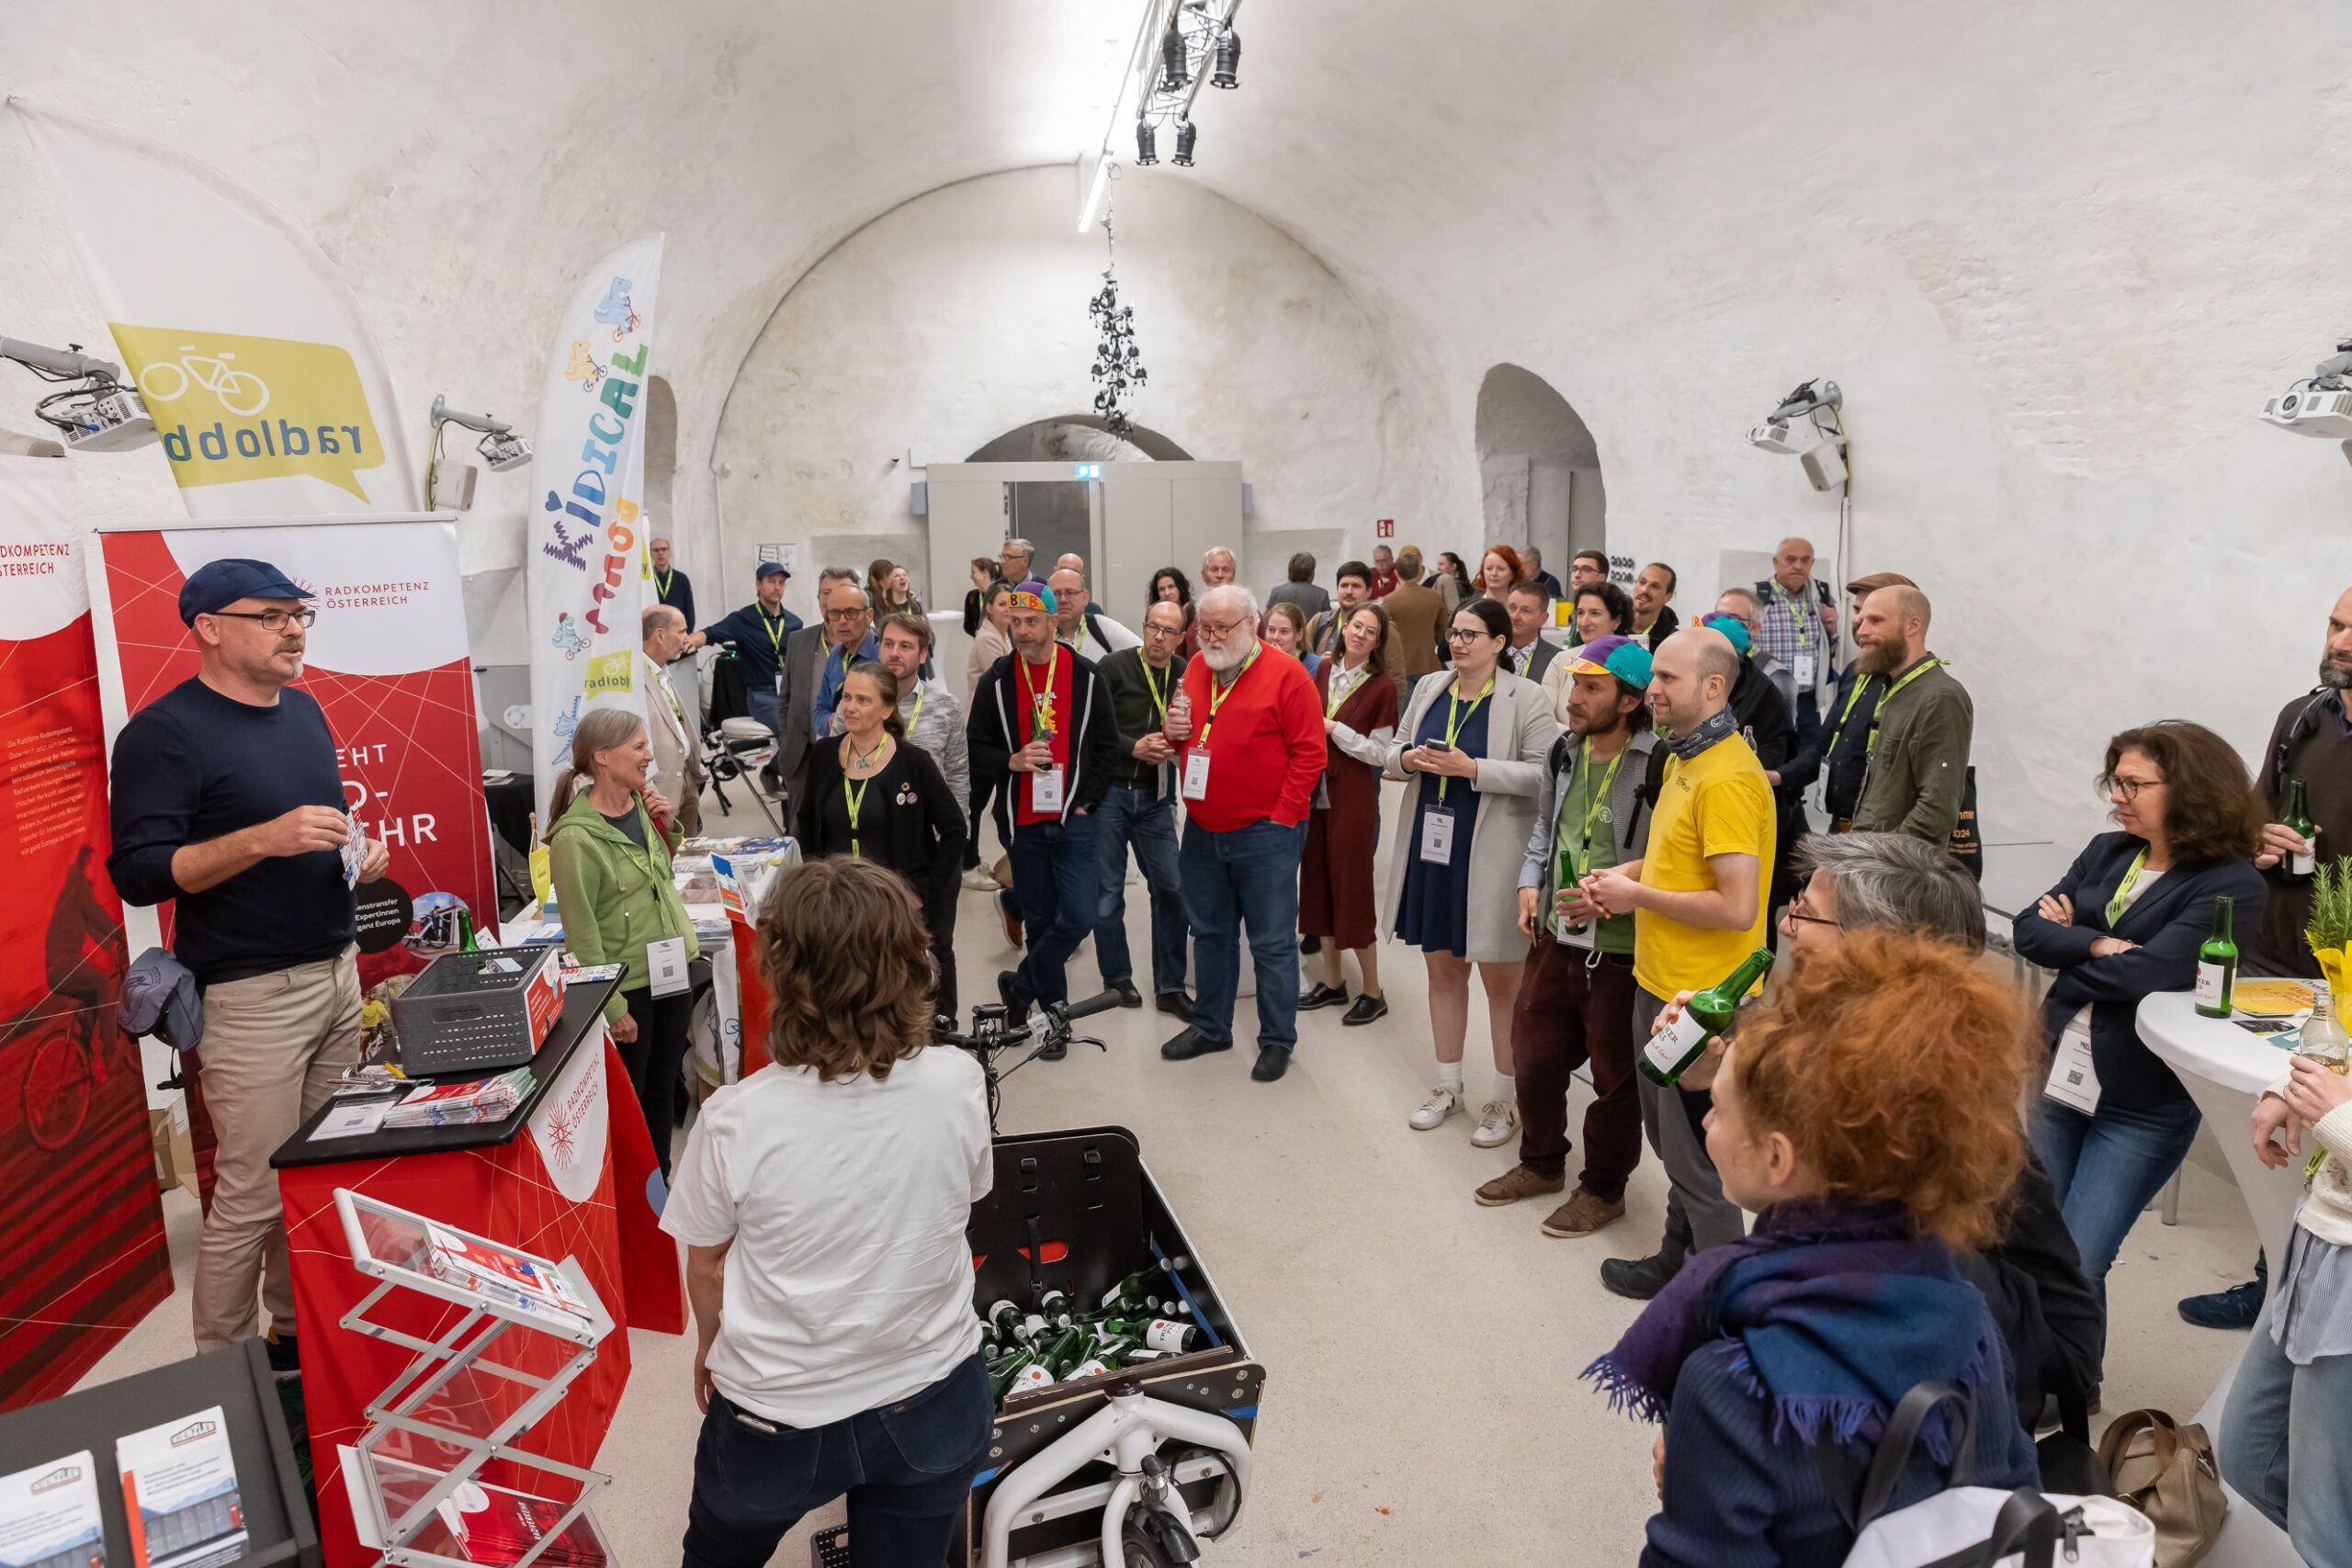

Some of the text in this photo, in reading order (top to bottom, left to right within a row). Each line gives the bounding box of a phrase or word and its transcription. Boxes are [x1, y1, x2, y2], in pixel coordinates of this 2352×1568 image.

[0, 544, 70, 558] DKOMPETENZ
[325, 581, 429, 596] RADKOMPETENZ
[327, 596, 408, 609] ÖSTERREICH
[355, 908, 400, 921] ExpertInnen
[356, 918, 401, 932] ganz Europa
[567, 1053, 600, 1110] RADKOMPETENZ
[571, 1084, 598, 1129] ÖSTERREICH
